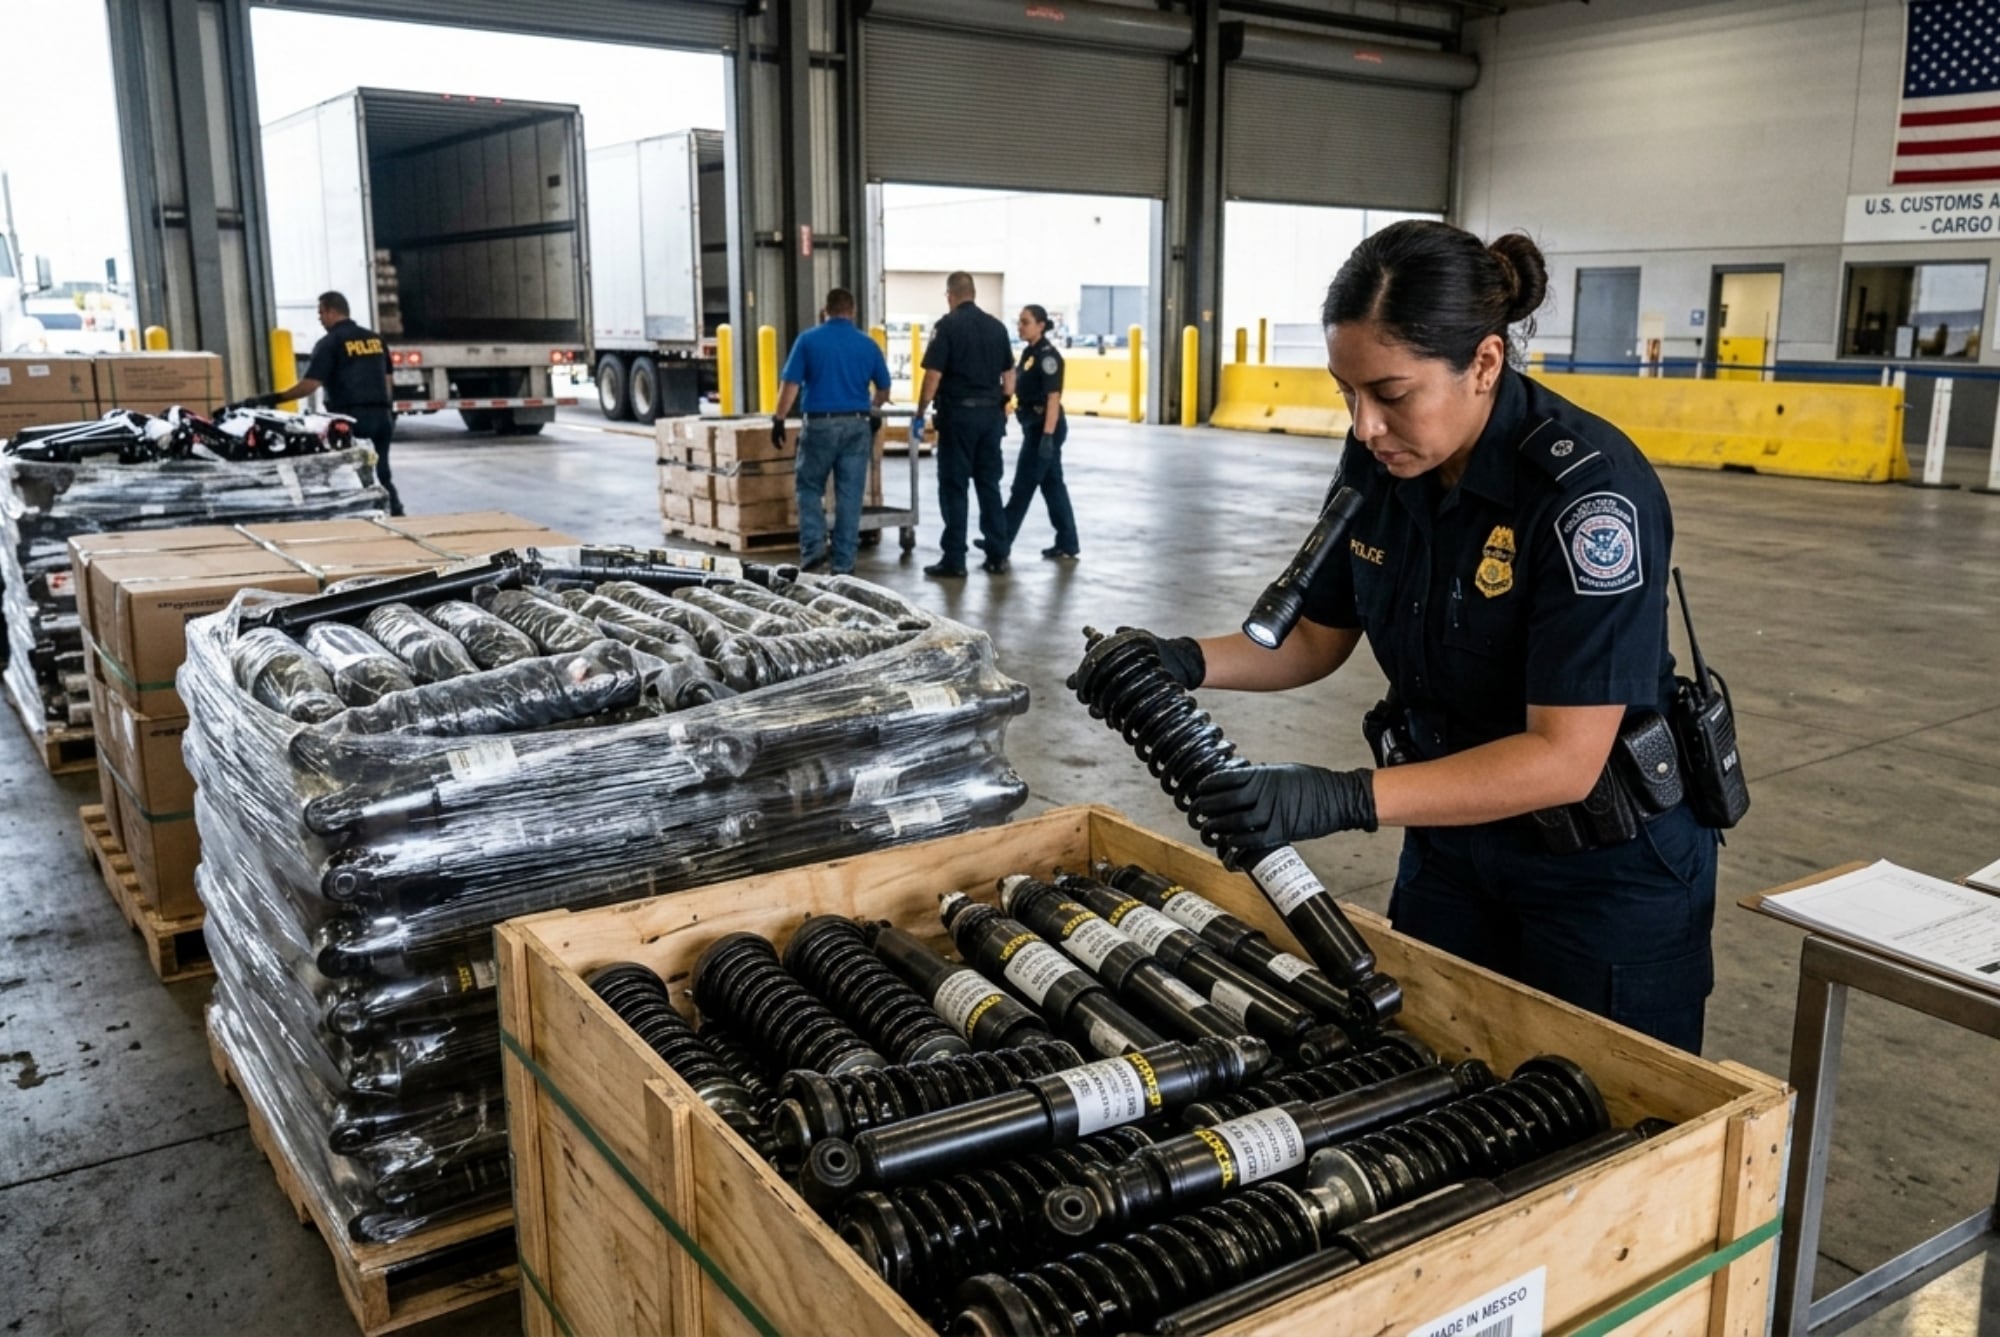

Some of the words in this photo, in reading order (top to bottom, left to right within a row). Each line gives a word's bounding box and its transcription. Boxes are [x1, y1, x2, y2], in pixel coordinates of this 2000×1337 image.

[1865, 198, 1895, 214] U.S.
[1900, 193, 1984, 213] CUSTOMS
[1931, 215, 1993, 234] CARGO
[1466, 1310, 1479, 1328] IN
[1482, 1286, 1528, 1320] MESSO
